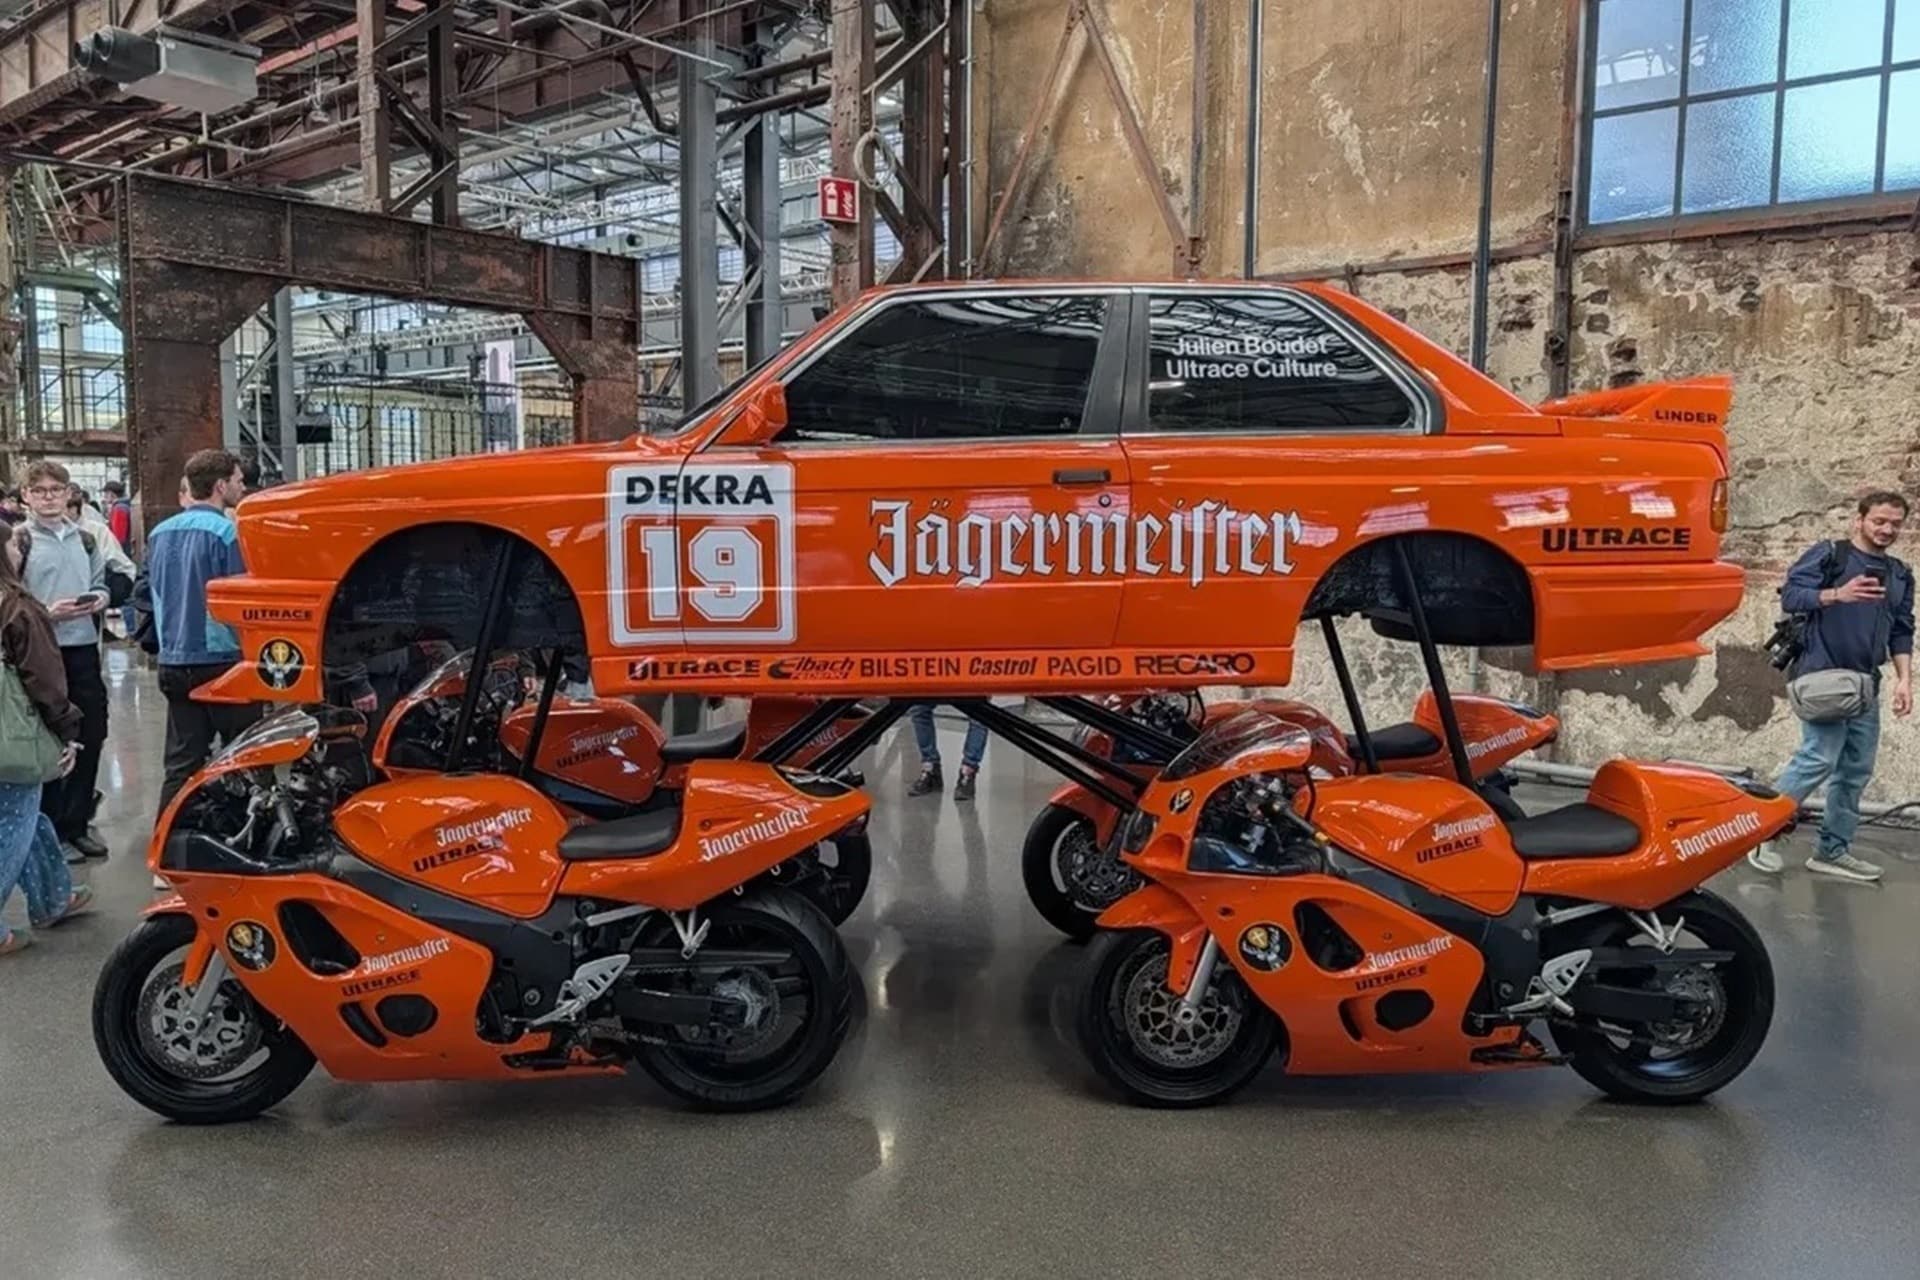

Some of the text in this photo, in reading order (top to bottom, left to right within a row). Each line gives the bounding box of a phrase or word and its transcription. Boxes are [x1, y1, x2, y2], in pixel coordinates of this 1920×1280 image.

[1172, 335, 1330, 356] Julien Boudet
[1166, 358, 1338, 379] Ultrace Culture
[1655, 409, 1718, 424] LINDER
[626, 475, 774, 505] DEKRA
[1542, 527, 1692, 553] ULTRACE
[640, 526, 764, 622] 19
[242, 608, 314, 622] ULTRACE
[628, 659, 761, 682] ULTRACE
[860, 657, 961, 678] BILSTEIN
[968, 656, 1038, 677] Castrol
[1047, 656, 1121, 677] PAGID
[1134, 653, 1256, 677] RECARO
[1416, 834, 1485, 865] ULTRACE
